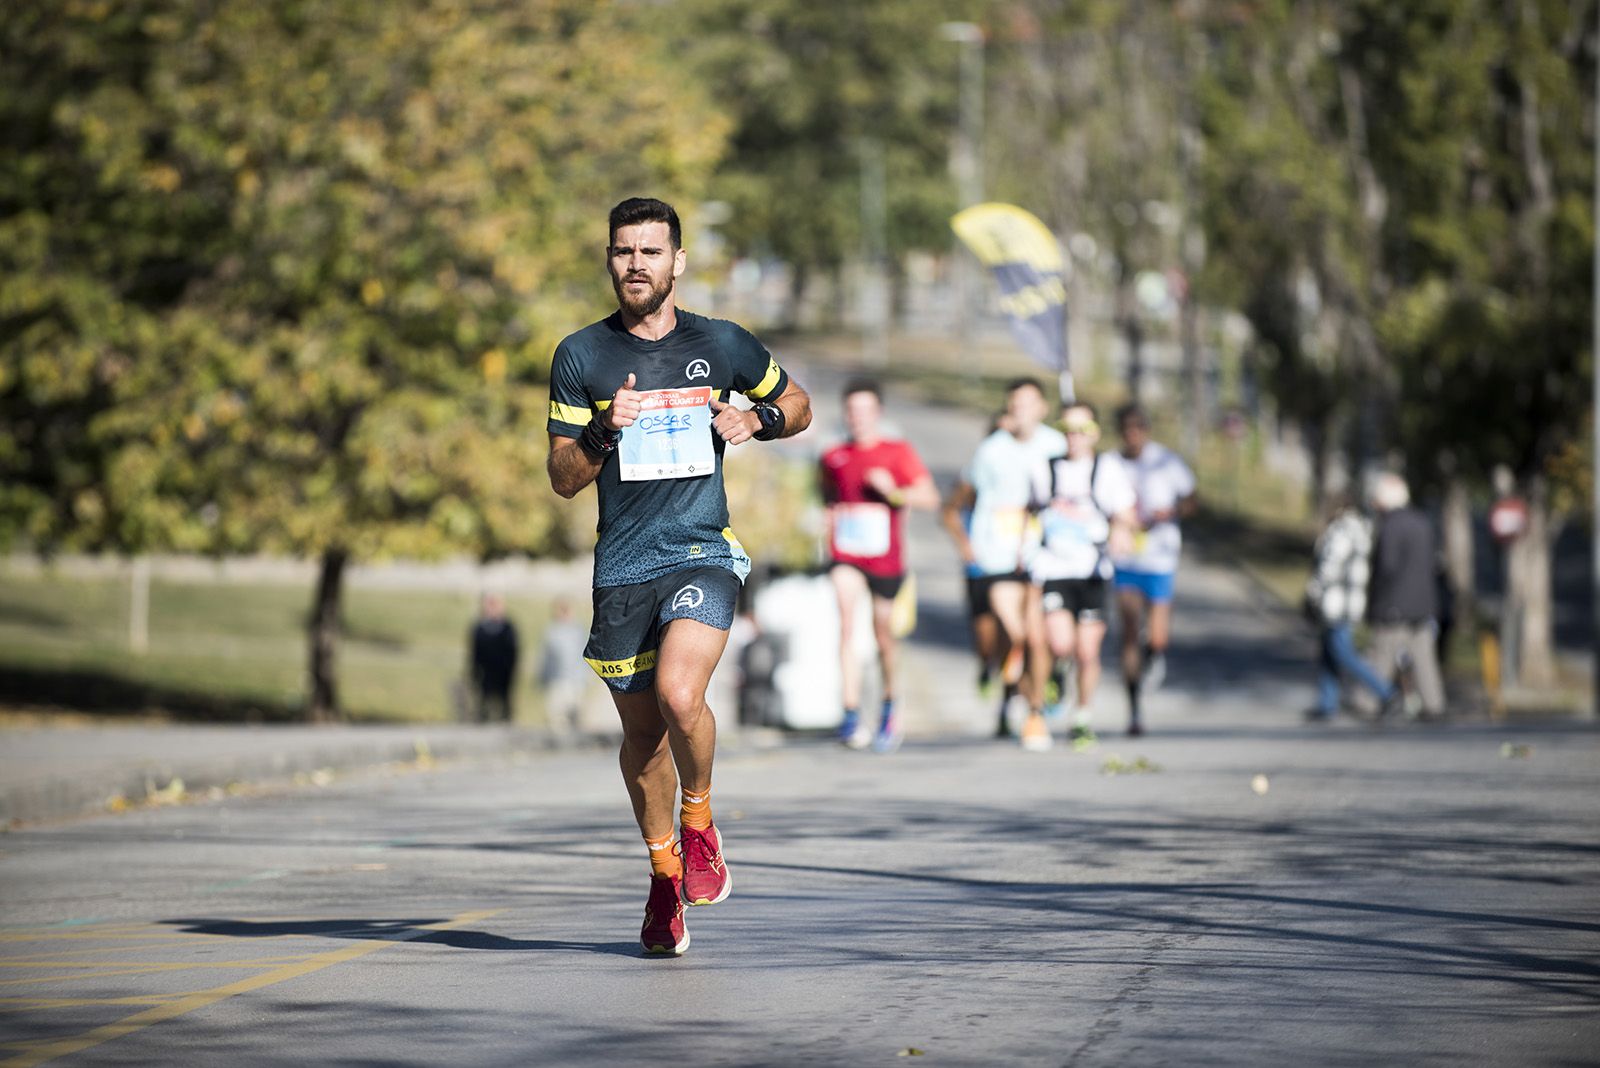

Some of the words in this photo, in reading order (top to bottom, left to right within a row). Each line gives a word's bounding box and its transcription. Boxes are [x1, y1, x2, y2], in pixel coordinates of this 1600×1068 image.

[695, 396, 705, 404] 23
[640, 414, 692, 430] OSCAR
[601, 664, 623, 674] AOS
